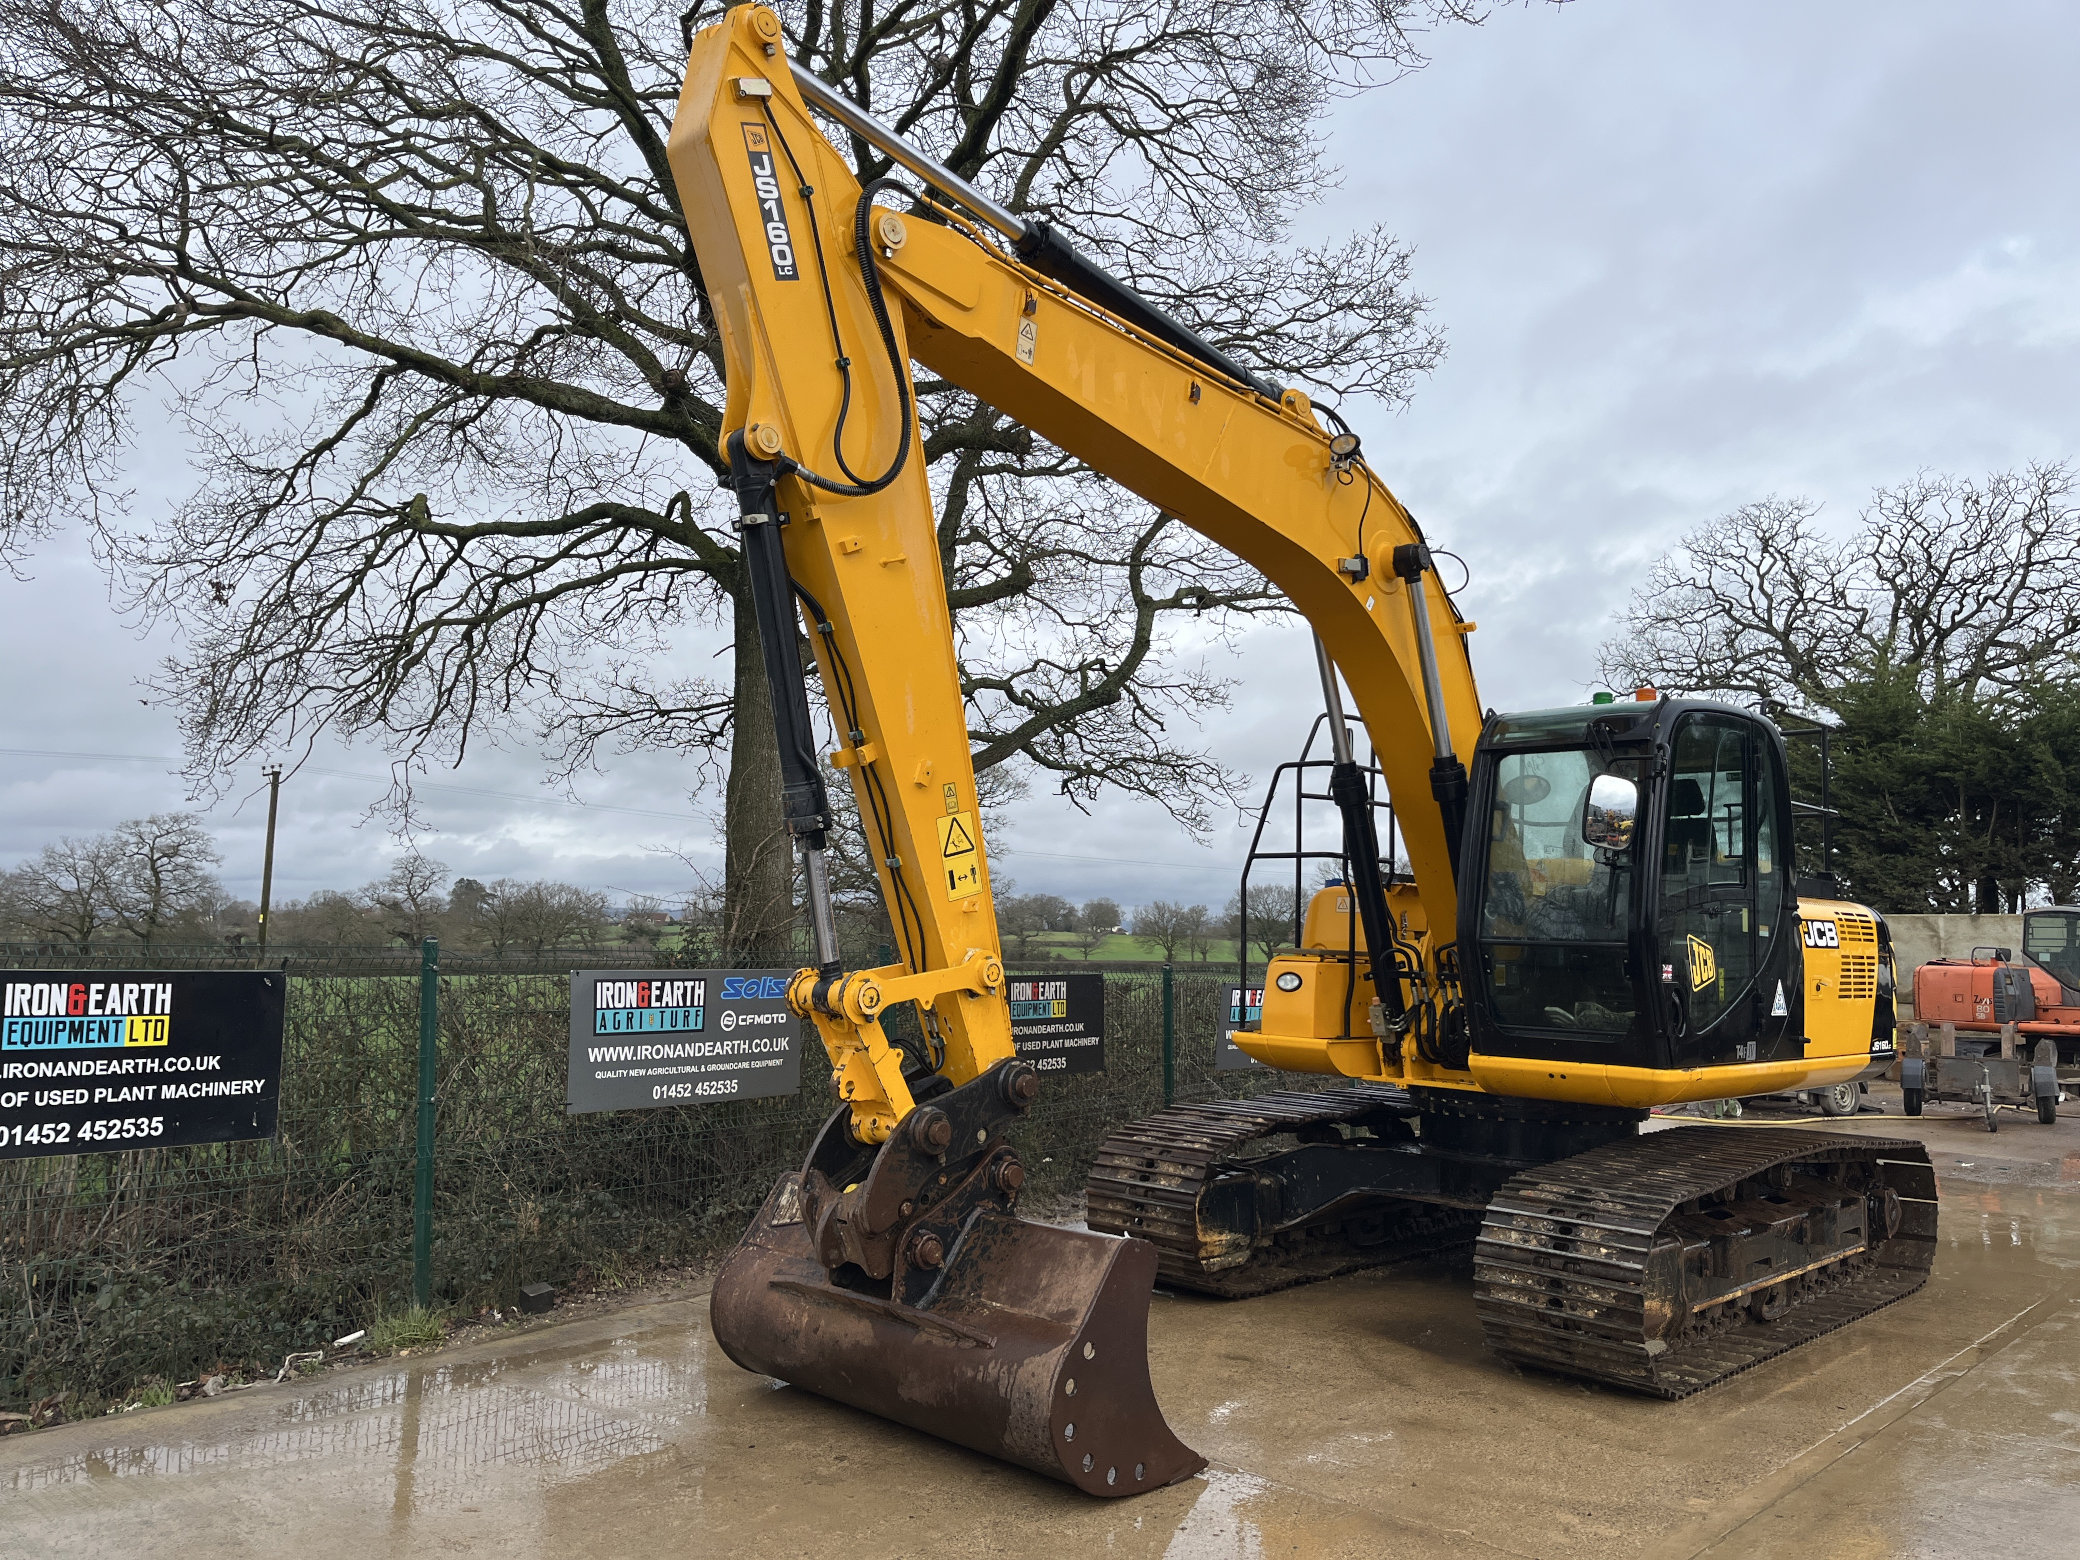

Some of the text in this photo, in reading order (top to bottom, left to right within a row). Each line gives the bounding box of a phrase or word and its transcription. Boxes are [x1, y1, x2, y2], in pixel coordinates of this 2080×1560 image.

[753, 154, 794, 275] JS160 LC
[1804, 920, 1839, 948] JCB
[1692, 941, 1714, 986] JCB
[738, 1013, 787, 1026] CFMOTO
[1012, 1001, 1065, 1017] EQUIPMENT LTD
[1976, 1005, 1990, 1013] 80
[599, 1010, 702, 1031] AGRI TURF
[7, 1018, 165, 1048] EQUIPMENT LTD
[588, 1037, 790, 1063] WWW.IRONANDEARTH.CO.UK
[1022, 1041, 1041, 1051] USED
[1042, 1040, 1063, 1049] PLANT
[1064, 1037, 1100, 1048] MACHINERY
[595, 1059, 784, 1079] QUALITY NEW AGRICULTURAL & GROUNDCARE EQUIPMENT
[1036, 1057, 1067, 1071] 452535
[0, 1079, 265, 1108] OF USED PLANT MACHINERY
[652, 1079, 738, 1100] 01452 452535
[77, 1116, 164, 1142] 452535
